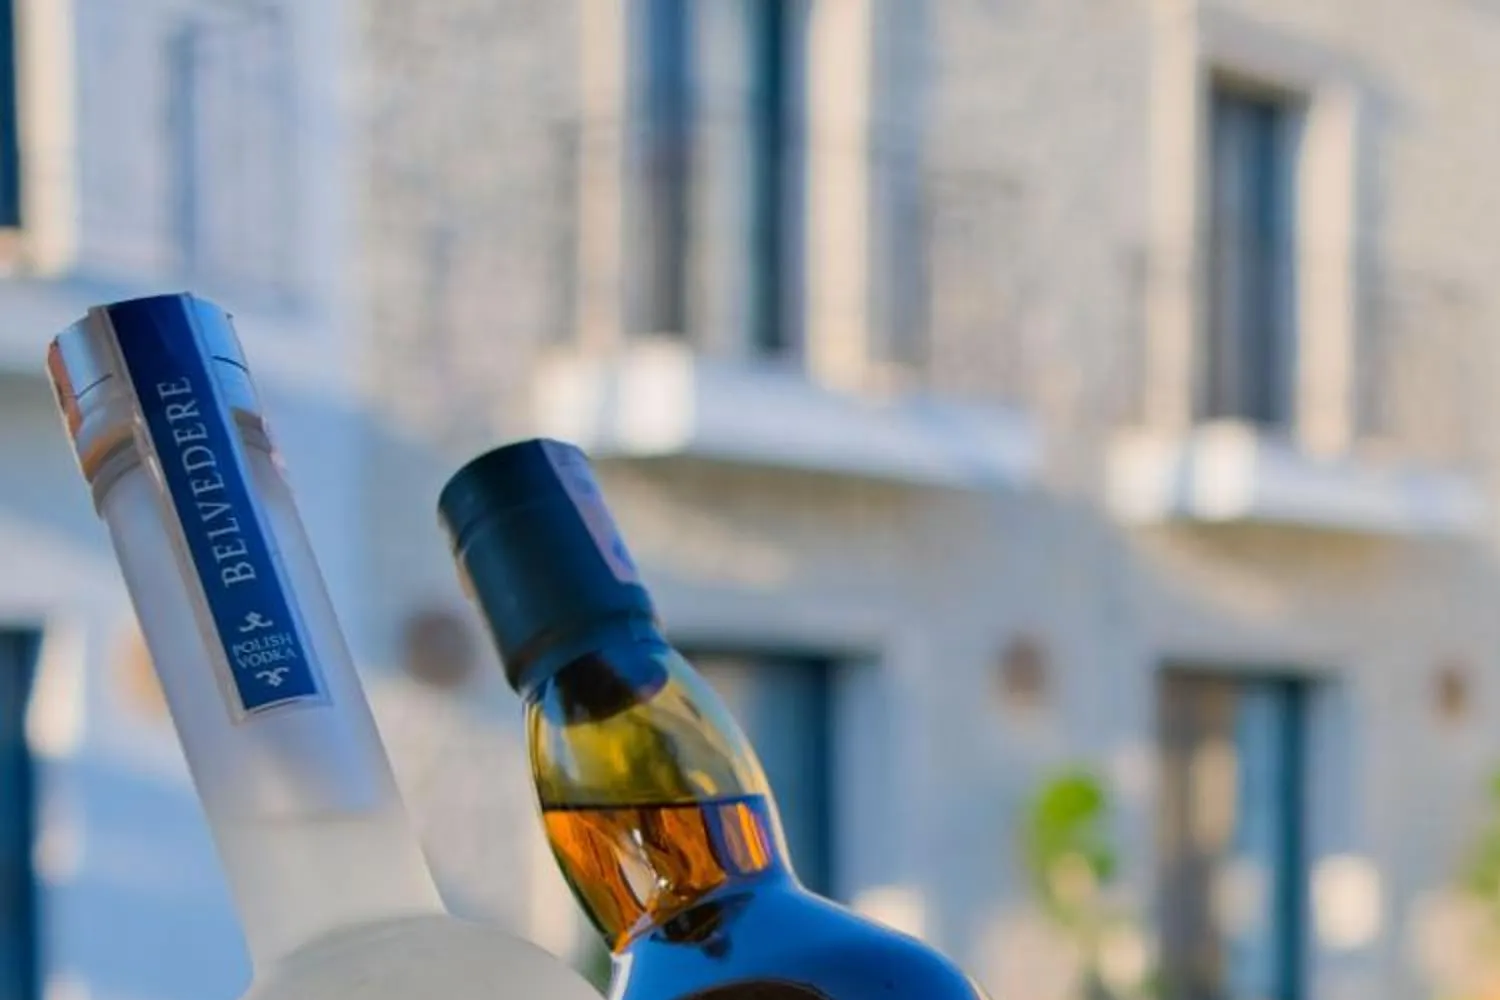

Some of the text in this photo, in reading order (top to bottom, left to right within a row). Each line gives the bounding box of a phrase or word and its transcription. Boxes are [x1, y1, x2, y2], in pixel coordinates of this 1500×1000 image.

[157, 376, 257, 589] BELVEDERE
[232, 632, 294, 658] POLISH
[236, 646, 298, 669] VODKA
